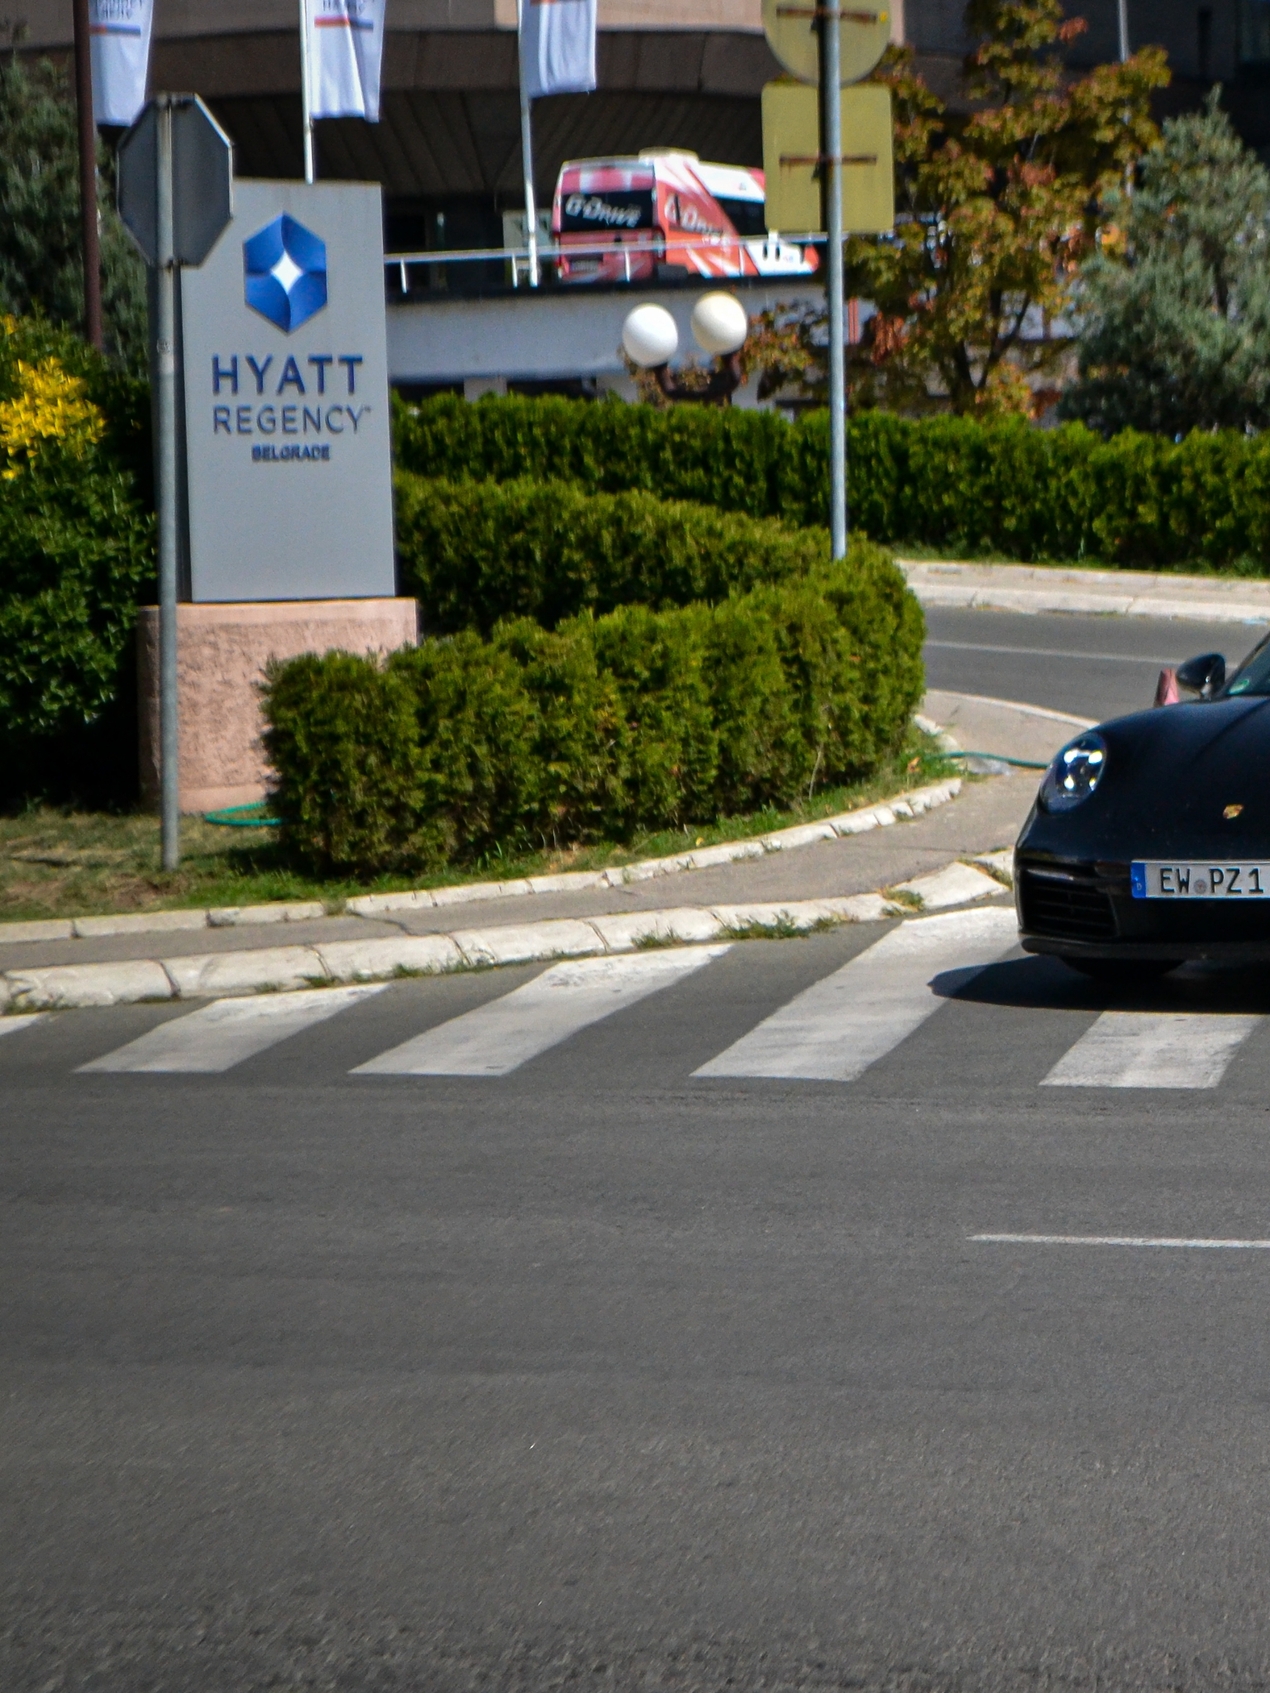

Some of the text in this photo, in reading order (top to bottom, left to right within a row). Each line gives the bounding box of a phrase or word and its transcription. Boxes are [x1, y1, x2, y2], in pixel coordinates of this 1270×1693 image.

[212, 353, 363, 395] HYATT
[252, 443, 330, 462] BELGRADE
[1159, 867, 1191, 894] EW
